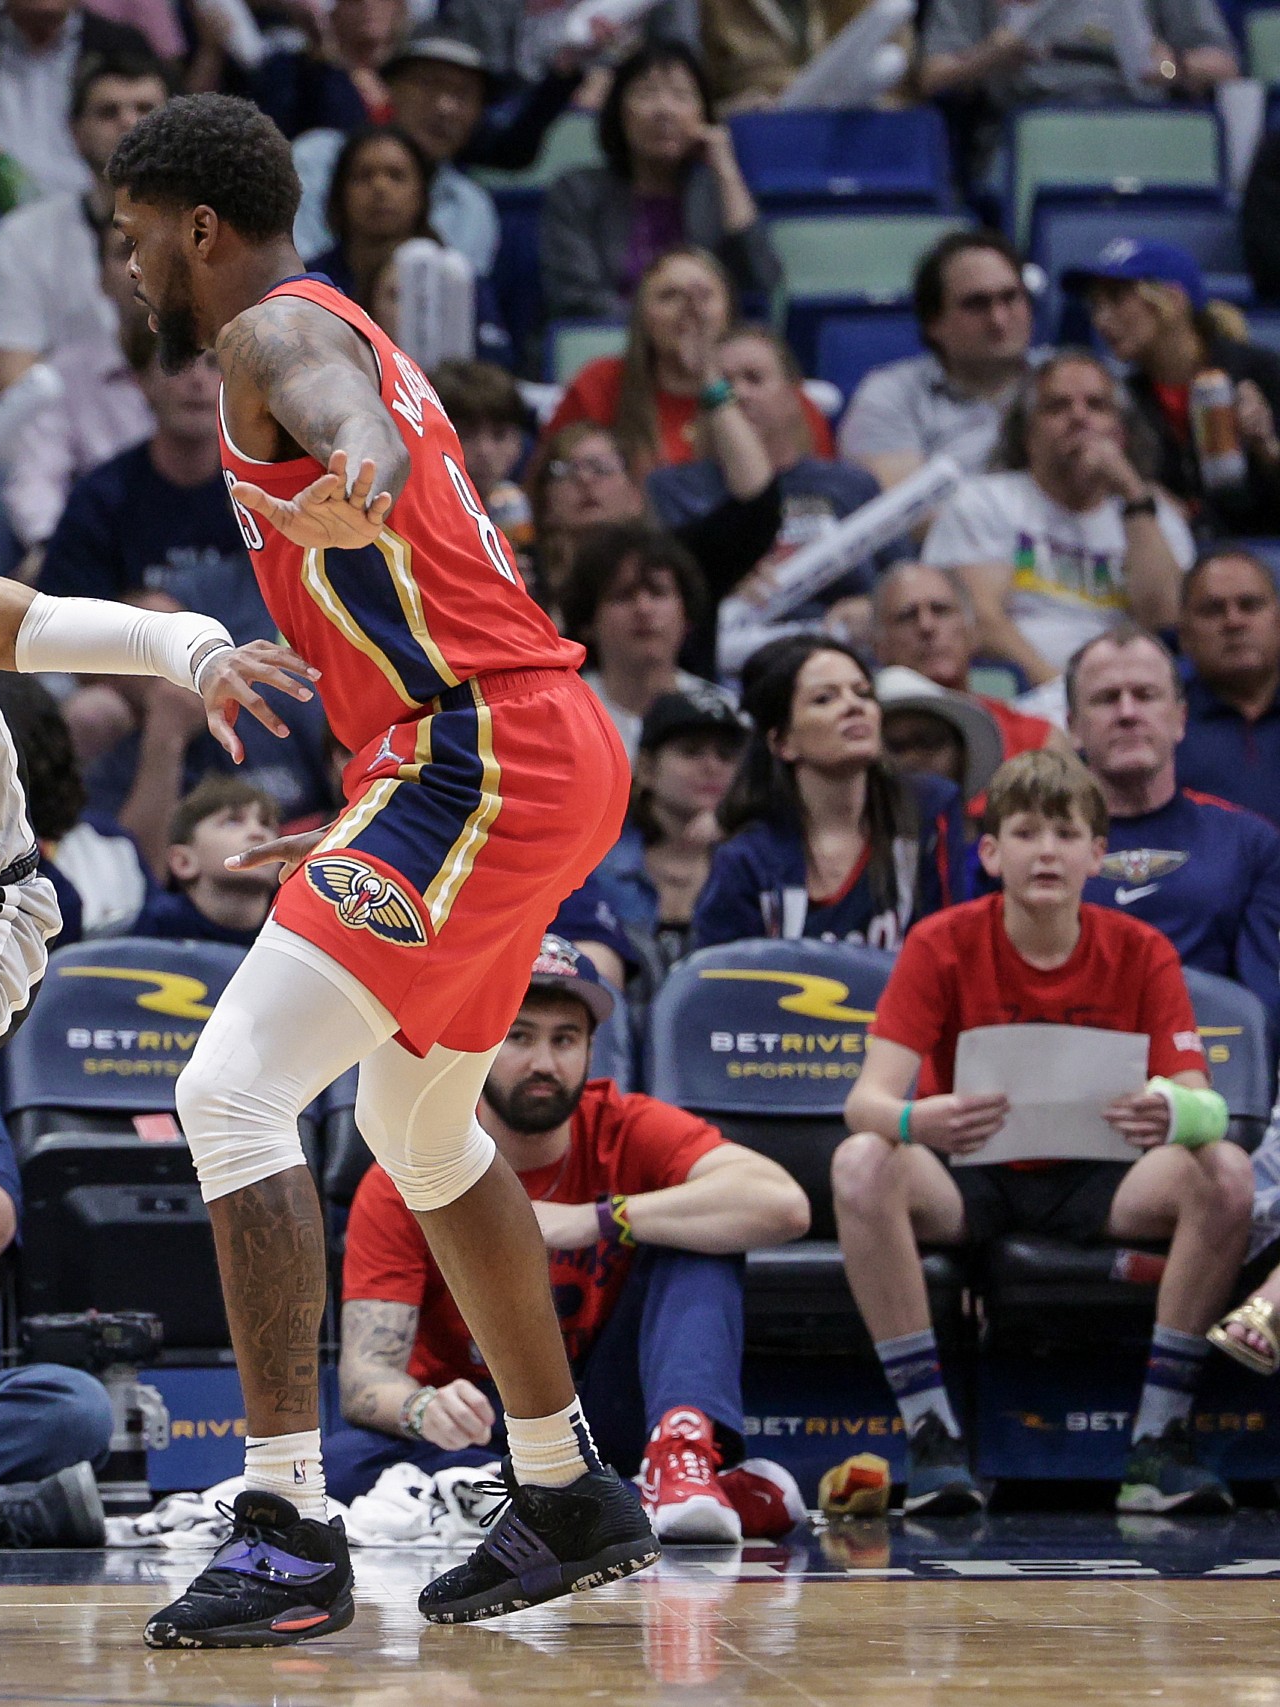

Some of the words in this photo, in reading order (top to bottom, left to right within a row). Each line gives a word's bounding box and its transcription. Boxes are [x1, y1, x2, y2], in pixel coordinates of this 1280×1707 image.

[441, 451, 517, 586] 8
[66, 1028, 199, 1051] BETRIV
[710, 1031, 875, 1053] BETRIVE
